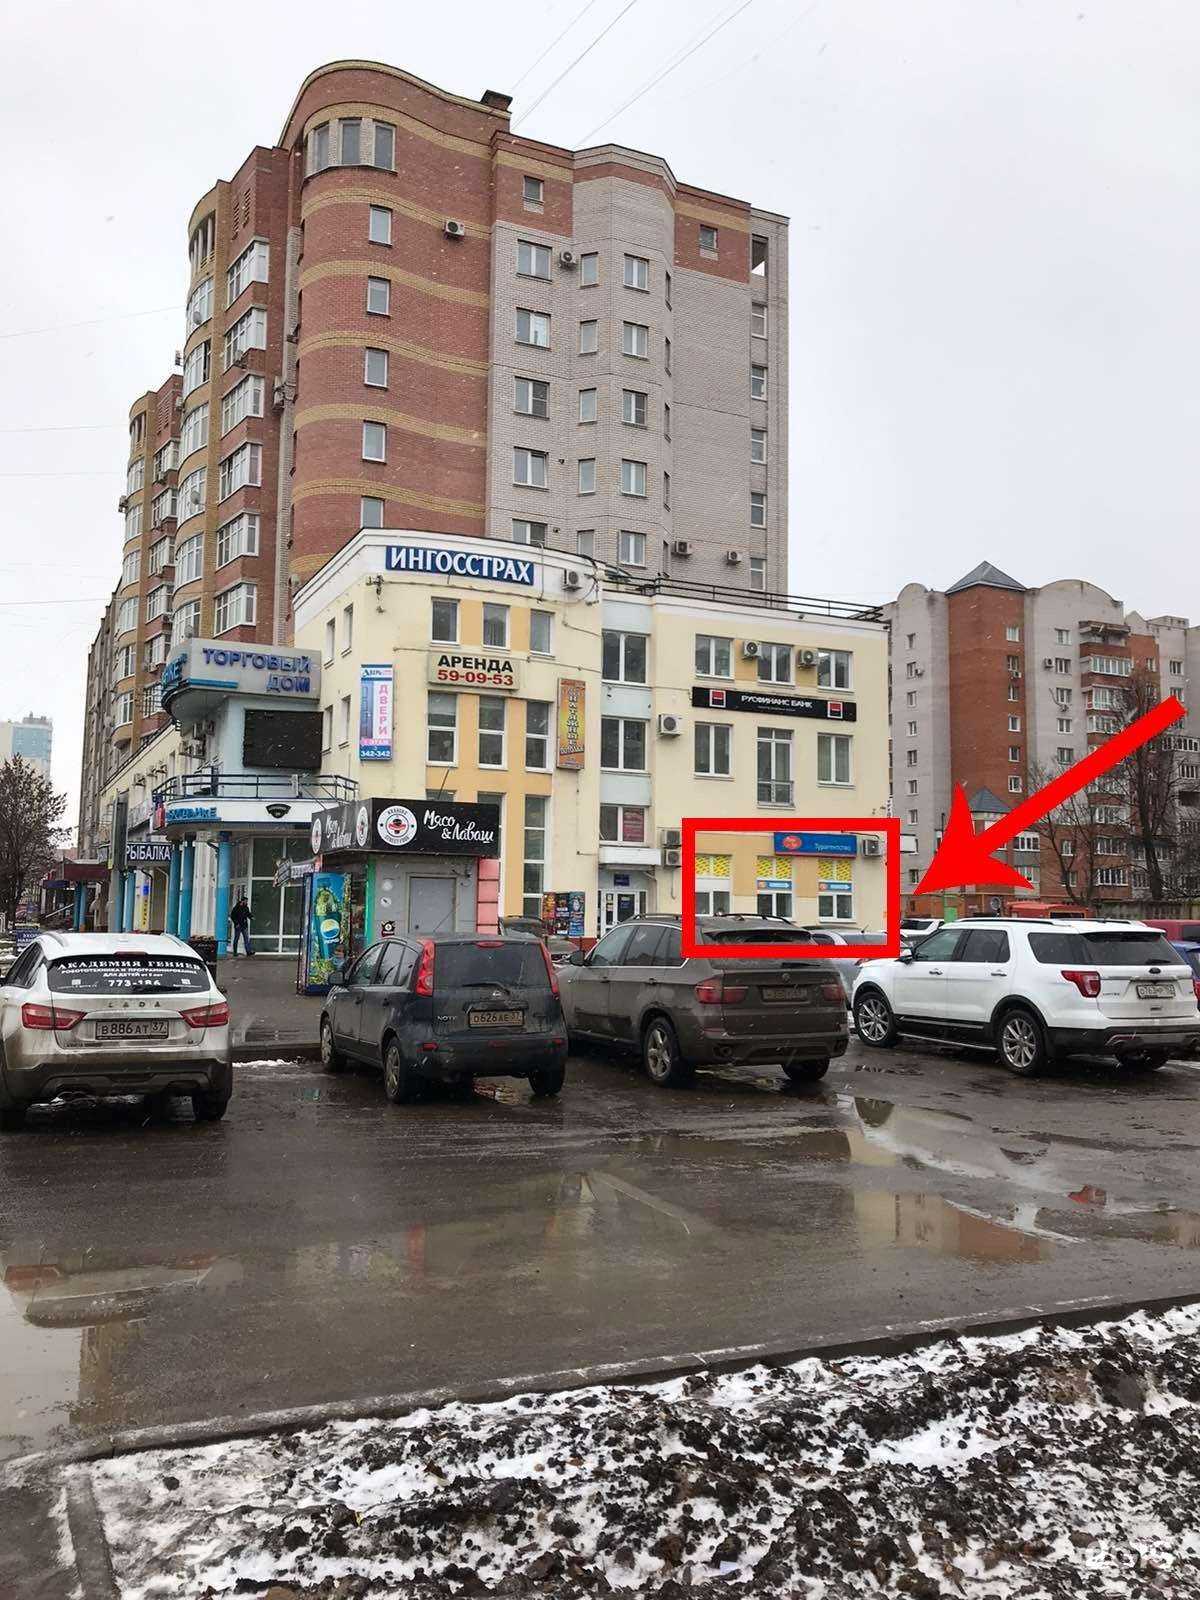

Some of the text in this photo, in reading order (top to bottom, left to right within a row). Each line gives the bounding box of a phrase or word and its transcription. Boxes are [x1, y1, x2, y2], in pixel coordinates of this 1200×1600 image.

[391, 547, 531, 583] ИНГОССТРАХ
[202, 647, 311, 673] ТОРГОВЫЙ
[437, 655, 514, 673] АРЕНДА
[266, 673, 311, 693] ДОМ
[437, 669, 514, 686] 59-09-53
[379, 684, 389, 735] ДВЕРИ
[741, 695, 813, 708] РУСФИНАНС БАНК
[424, 810, 455, 830] Мясо
[126, 844, 171, 860] РЫБАЛКА
[57, 960, 201, 970] АКАДЕМИЯ ГЕНИЕВ
[108, 979, 161, 988] 773-186
[153, 1022, 164, 1031] 37
